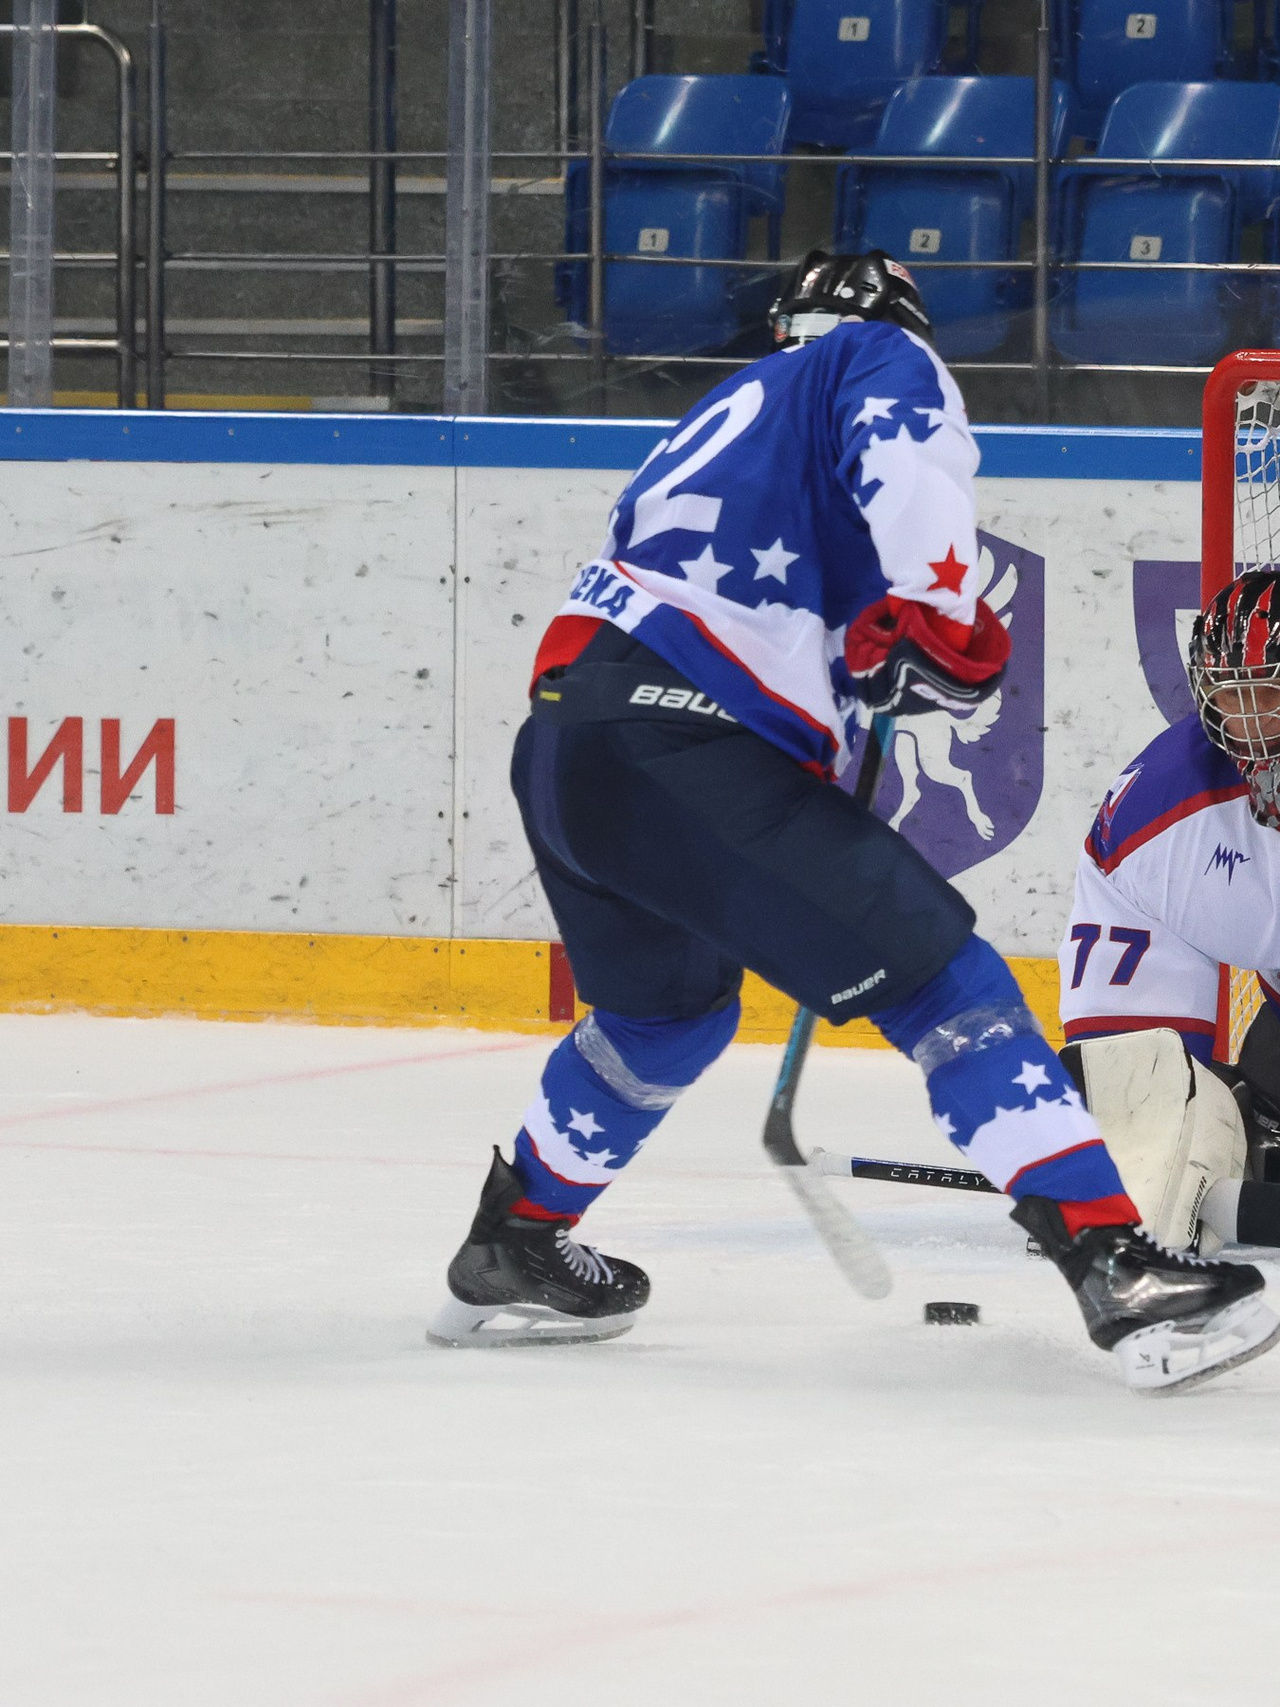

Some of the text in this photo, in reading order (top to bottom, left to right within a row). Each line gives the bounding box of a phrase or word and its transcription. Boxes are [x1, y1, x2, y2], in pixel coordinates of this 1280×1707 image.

[602, 380, 764, 558] 2
[569, 565, 635, 618] ЕКА
[1070, 923, 1151, 989] 77
[831, 968, 886, 1005] BAUER
[890, 1167, 996, 1188] CATALY
